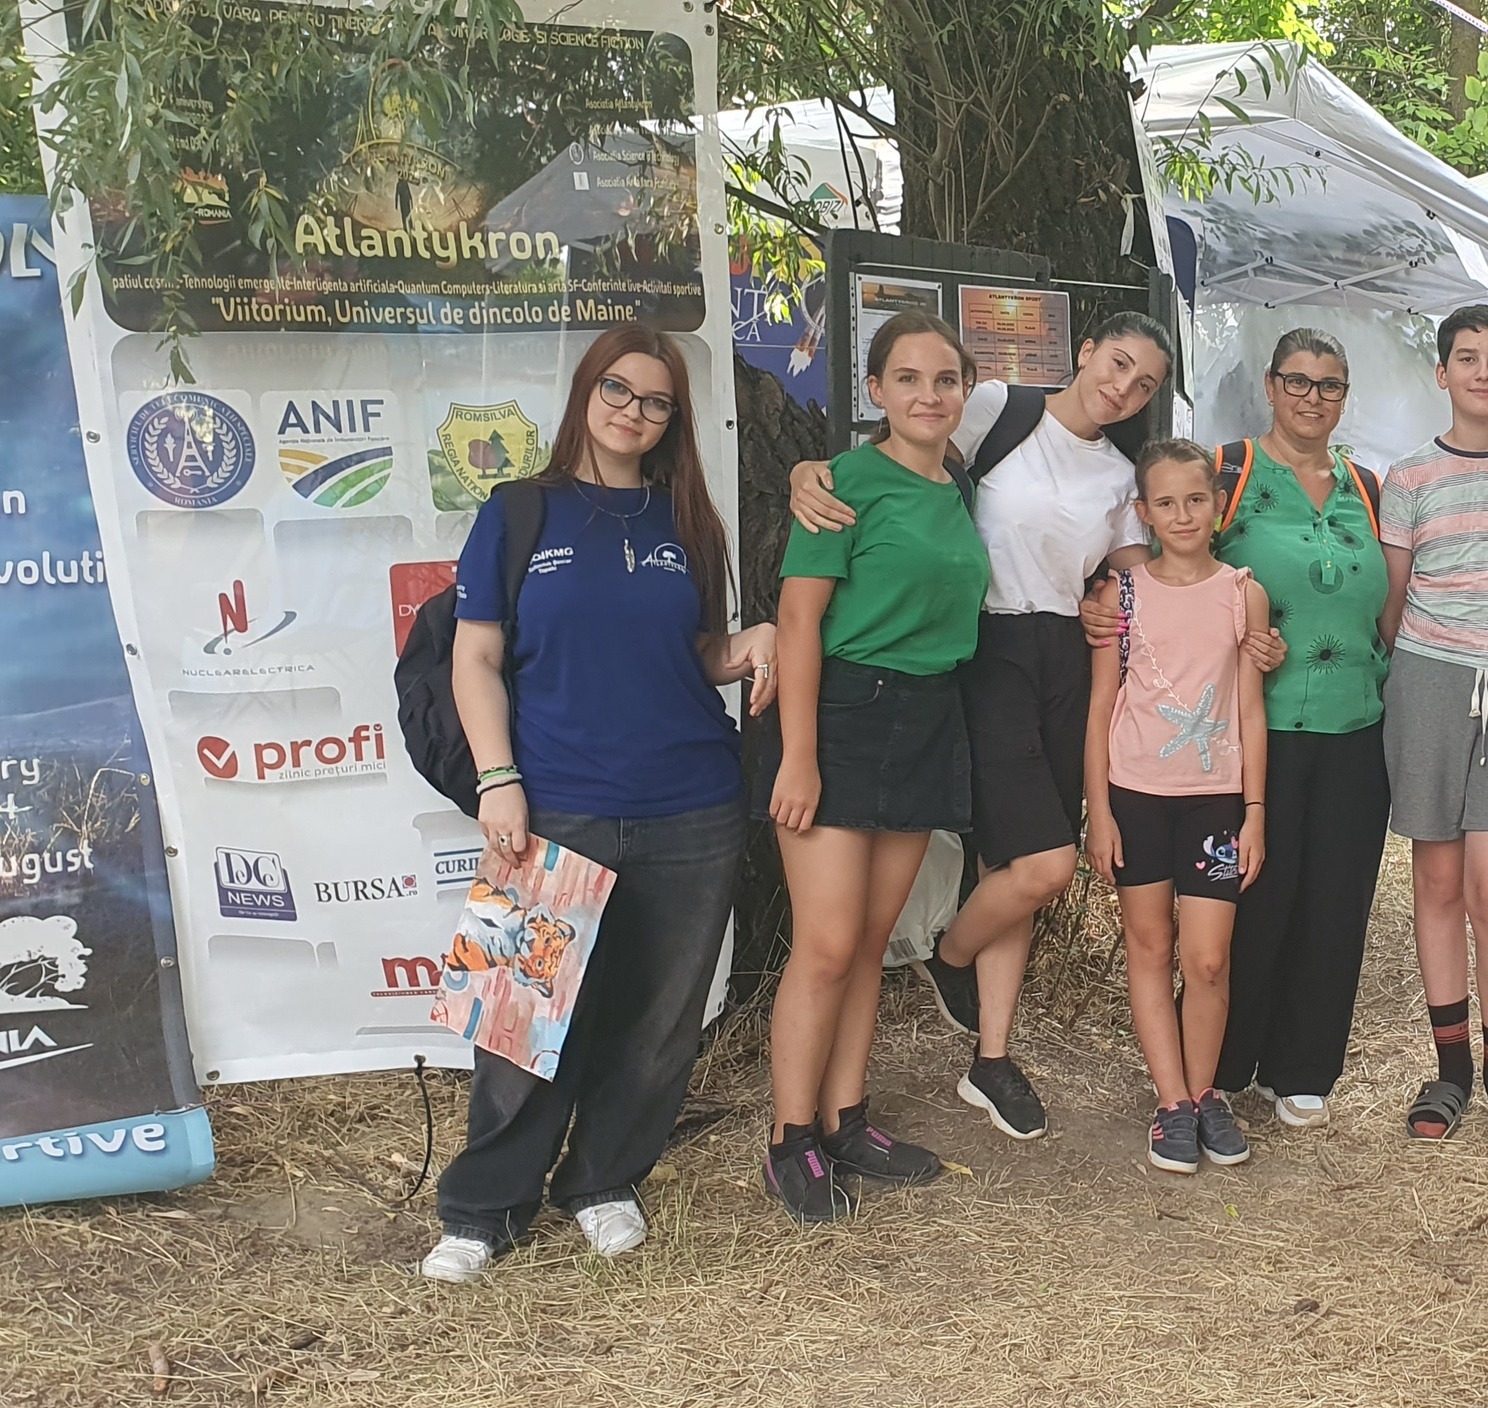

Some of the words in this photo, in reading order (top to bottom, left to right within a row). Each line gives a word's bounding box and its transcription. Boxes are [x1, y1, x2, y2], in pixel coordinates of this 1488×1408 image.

[223, 4, 261, 21] VARA
[550, 32, 599, 48] SCIENCE
[601, 36, 645, 50] FICTION
[294, 214, 561, 269] Atlantykron
[111, 275, 142, 291] patiul
[673, 282, 702, 298] sportive
[334, 299, 436, 326] Universul
[440, 301, 464, 325] de
[469, 300, 543, 326] dincolo
[549, 302, 571, 324] de
[277, 399, 384, 436] ANIF
[455, 407, 516, 422] ROMSILVA
[442, 433, 461, 468] REGIA
[457, 467, 489, 500] NATION
[182, 664, 316, 677] NUCLEARELECTRICA
[253, 723, 386, 780] profi
[219, 850, 280, 888] DC
[227, 891, 285, 907] NEWS
[314, 876, 406, 903] BURSA
